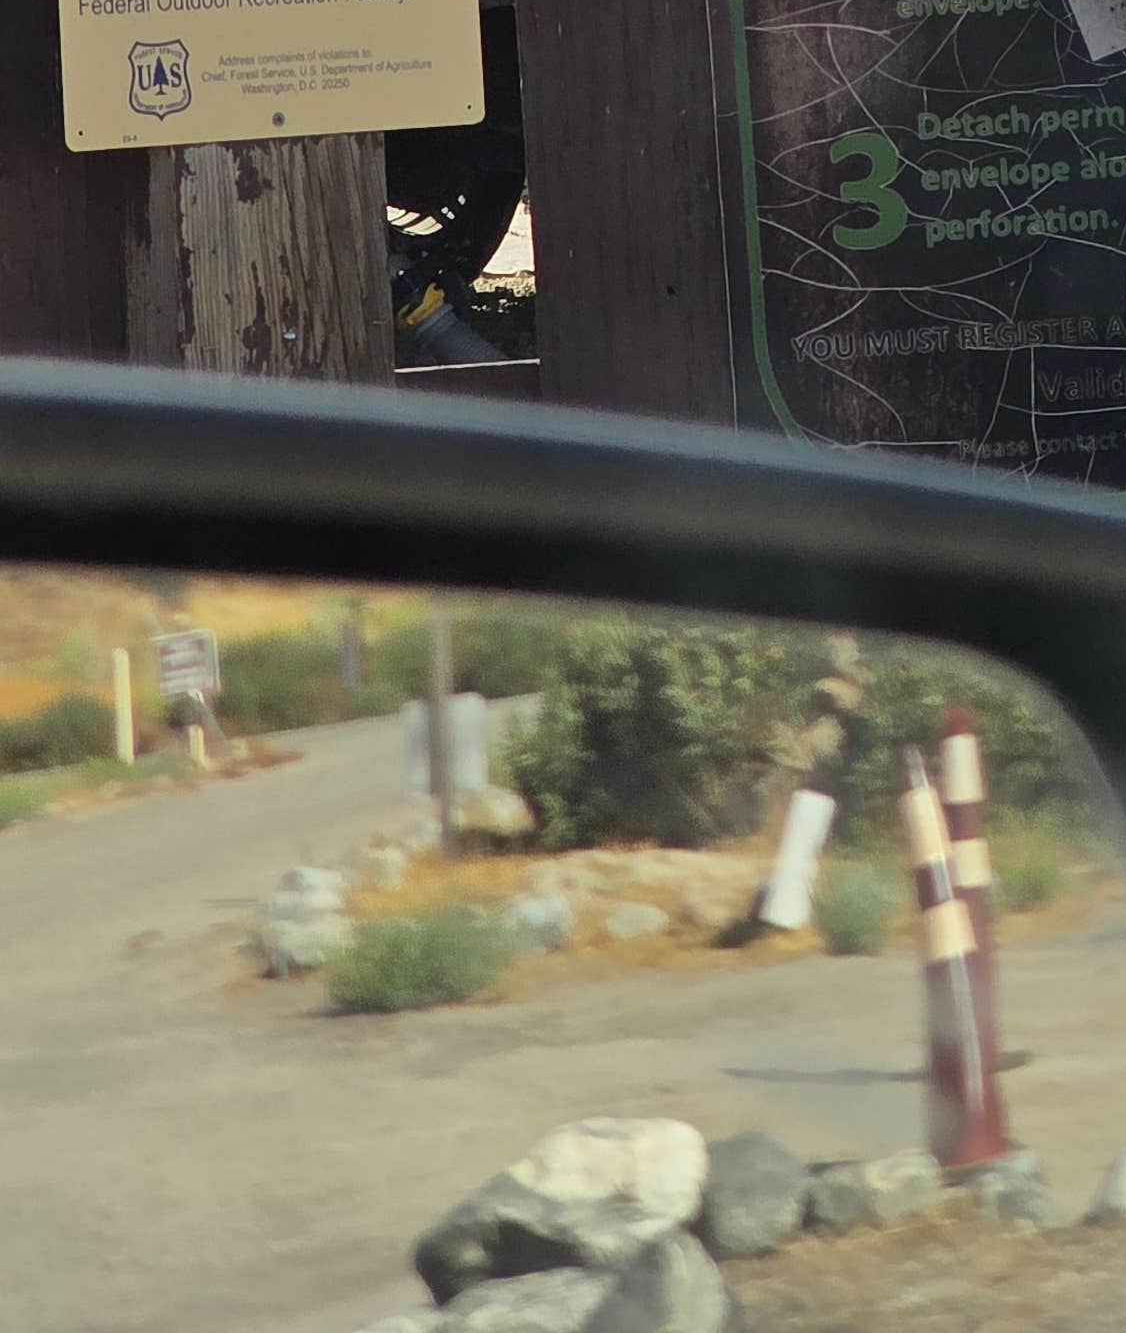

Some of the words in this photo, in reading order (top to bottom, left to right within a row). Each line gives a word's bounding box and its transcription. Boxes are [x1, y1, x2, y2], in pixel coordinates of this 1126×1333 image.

[218, 54, 255, 66] Address
[307, 50, 316, 61] of
[230, 69, 258, 81] Forest
[321, 62, 373, 76] Department
[386, 59, 432, 74] Agriculture
[918, 108, 1031, 140] Detach
[920, 159, 1071, 191] envelope
[830, 132, 907, 251] 3
[926, 207, 1117, 248] perforation.
[790, 334, 856, 363] YOU
[864, 325, 951, 357] MUST
[958, 316, 1100, 349] REGISTER
